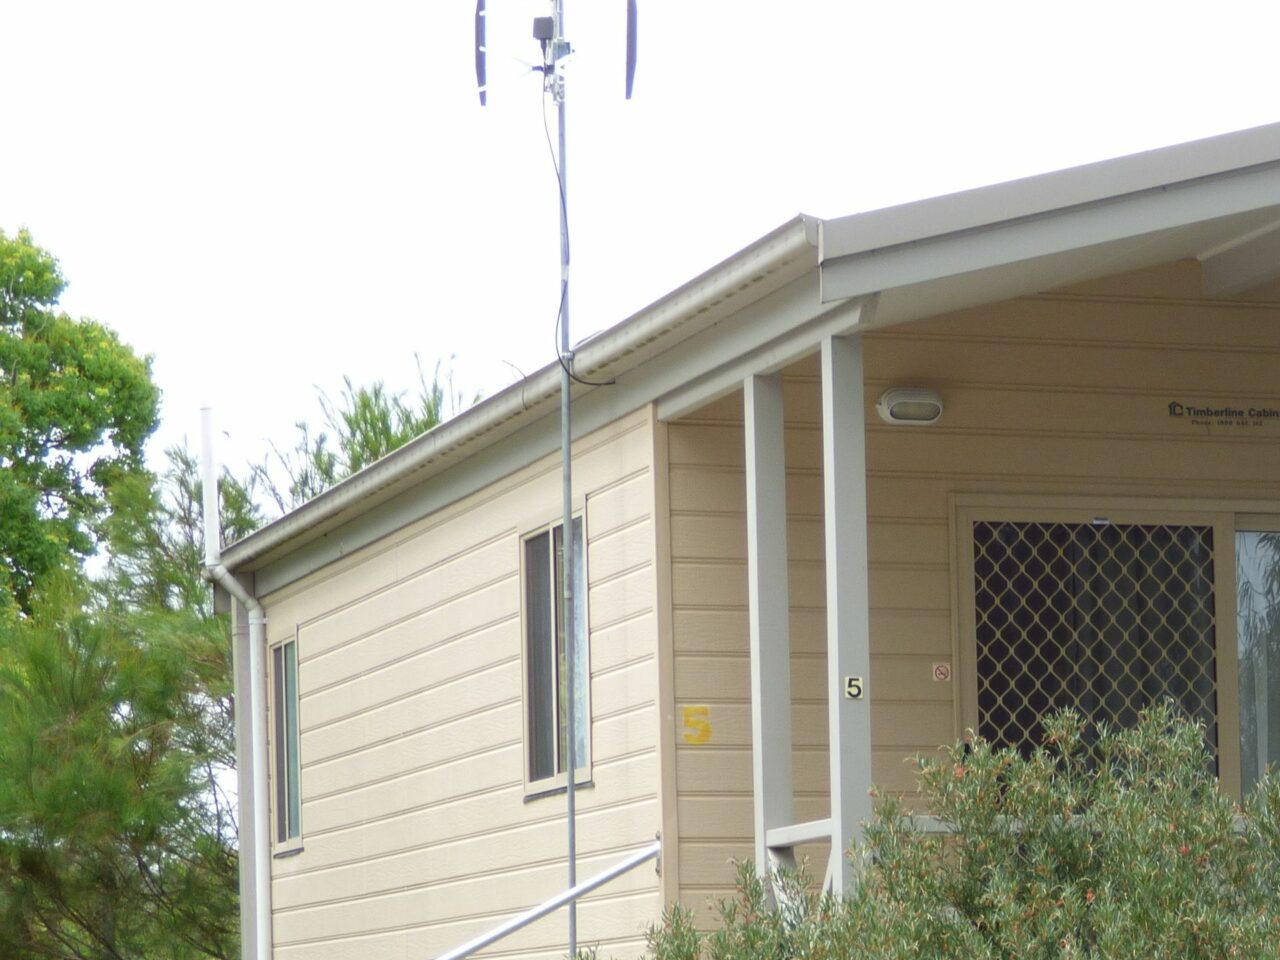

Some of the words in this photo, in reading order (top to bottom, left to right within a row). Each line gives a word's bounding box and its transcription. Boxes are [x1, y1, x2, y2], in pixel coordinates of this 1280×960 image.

[1186, 406, 1245, 417] Timberline
[848, 677, 862, 698] 5
[683, 705, 712, 745] 5
